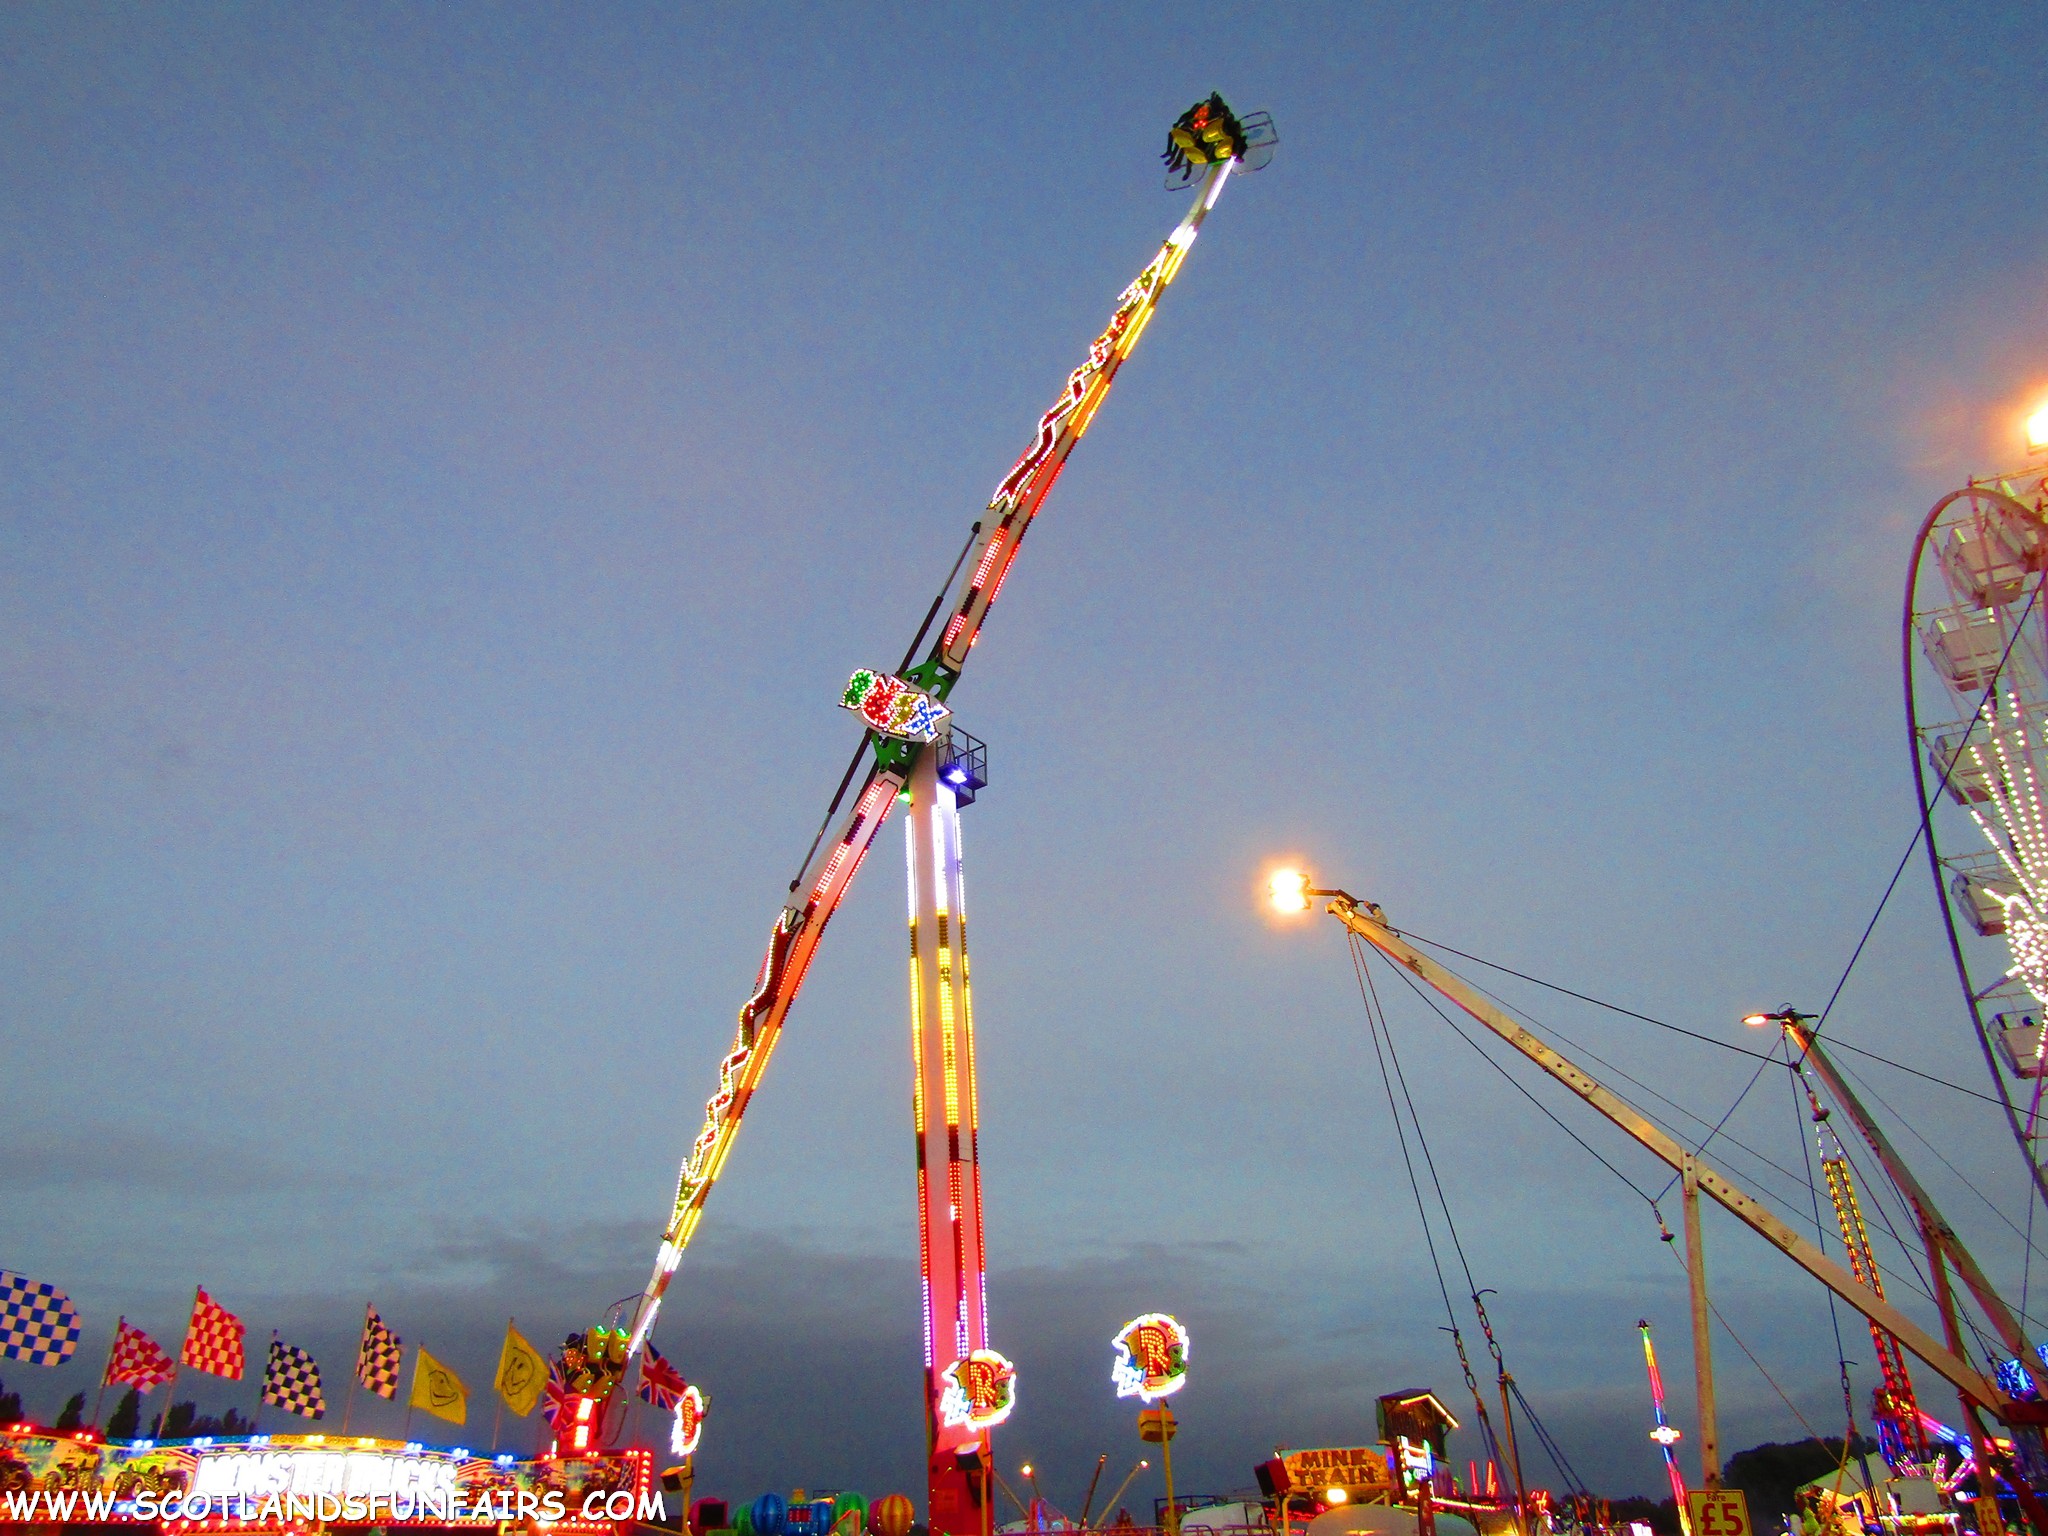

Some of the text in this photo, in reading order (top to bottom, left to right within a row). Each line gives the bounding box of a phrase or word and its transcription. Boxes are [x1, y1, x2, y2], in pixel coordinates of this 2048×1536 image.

[1300, 1449, 1367, 1468] MINE
[1295, 1466, 1376, 1486] TRAIN
[1706, 1493, 1727, 1502] Fare
[1700, 1503, 1744, 1535] £5
